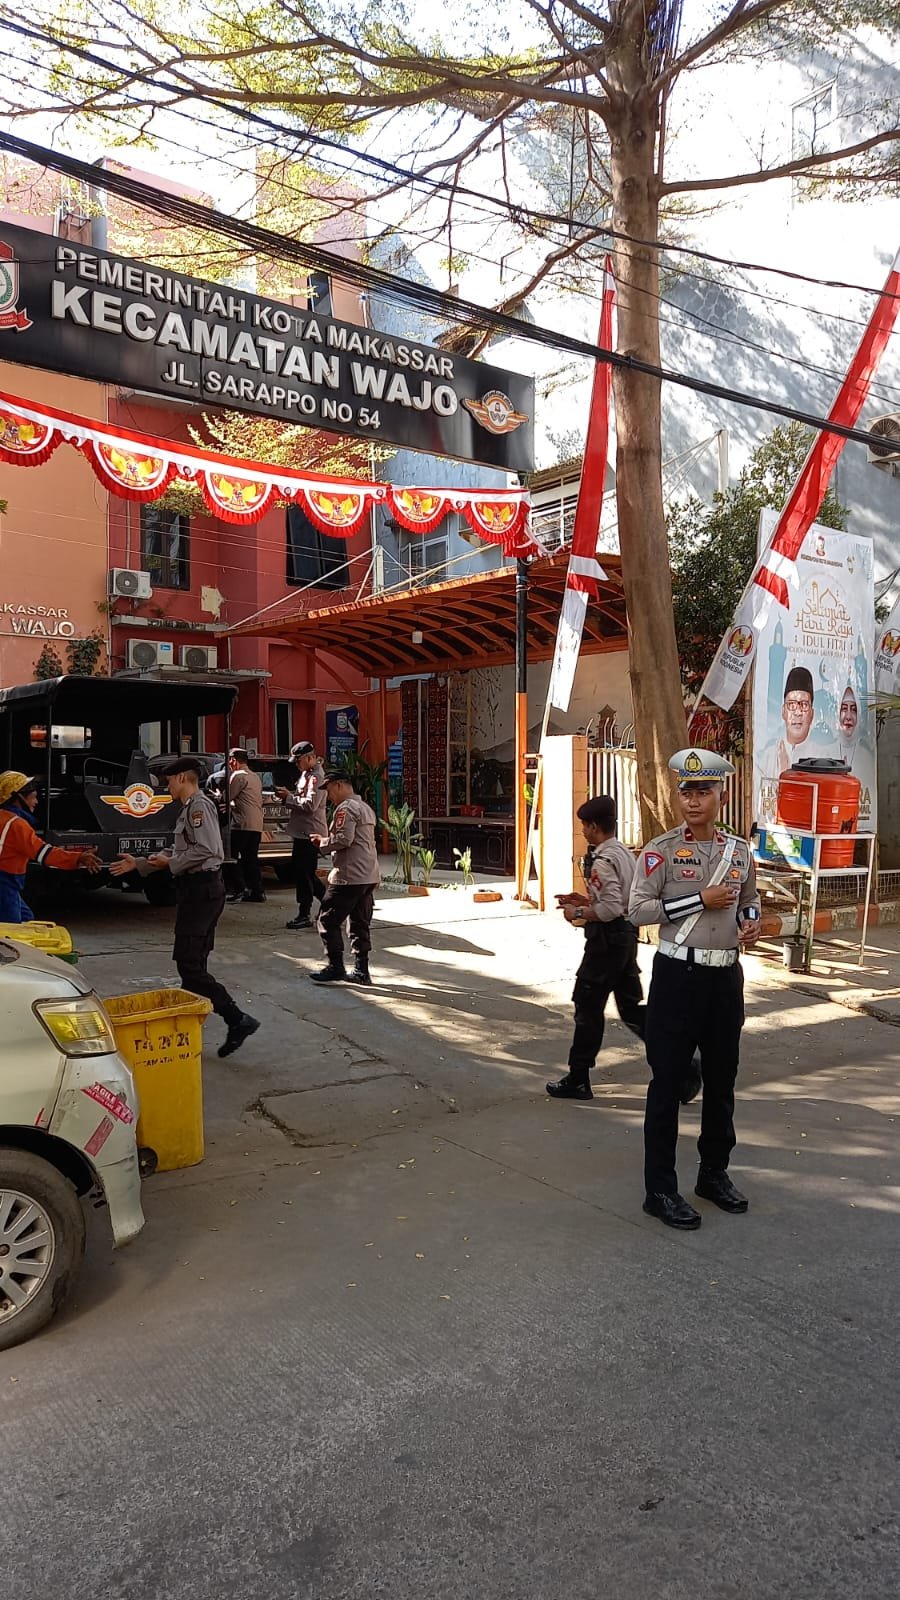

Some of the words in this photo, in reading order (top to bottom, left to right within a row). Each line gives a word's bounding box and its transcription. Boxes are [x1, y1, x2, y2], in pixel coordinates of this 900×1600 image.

[56, 246, 246, 322] PEMERINTAH
[253, 303, 323, 343] KOTA
[327, 325, 455, 379] MAKASSAR
[52, 280, 340, 389] KECAMATAN
[351, 361, 458, 417] WAJO
[163, 361, 199, 388] JL.
[206, 371, 316, 415] SARAPPO
[322, 398, 353, 423] NO
[359, 408, 381, 429] 54
[0, 603, 68, 618] KASSAR
[11, 618, 75, 637] WAJO
[803, 635, 825, 649] IDUL
[134, 840, 151, 849] 1342
[673, 858, 702, 866] RAMLI
